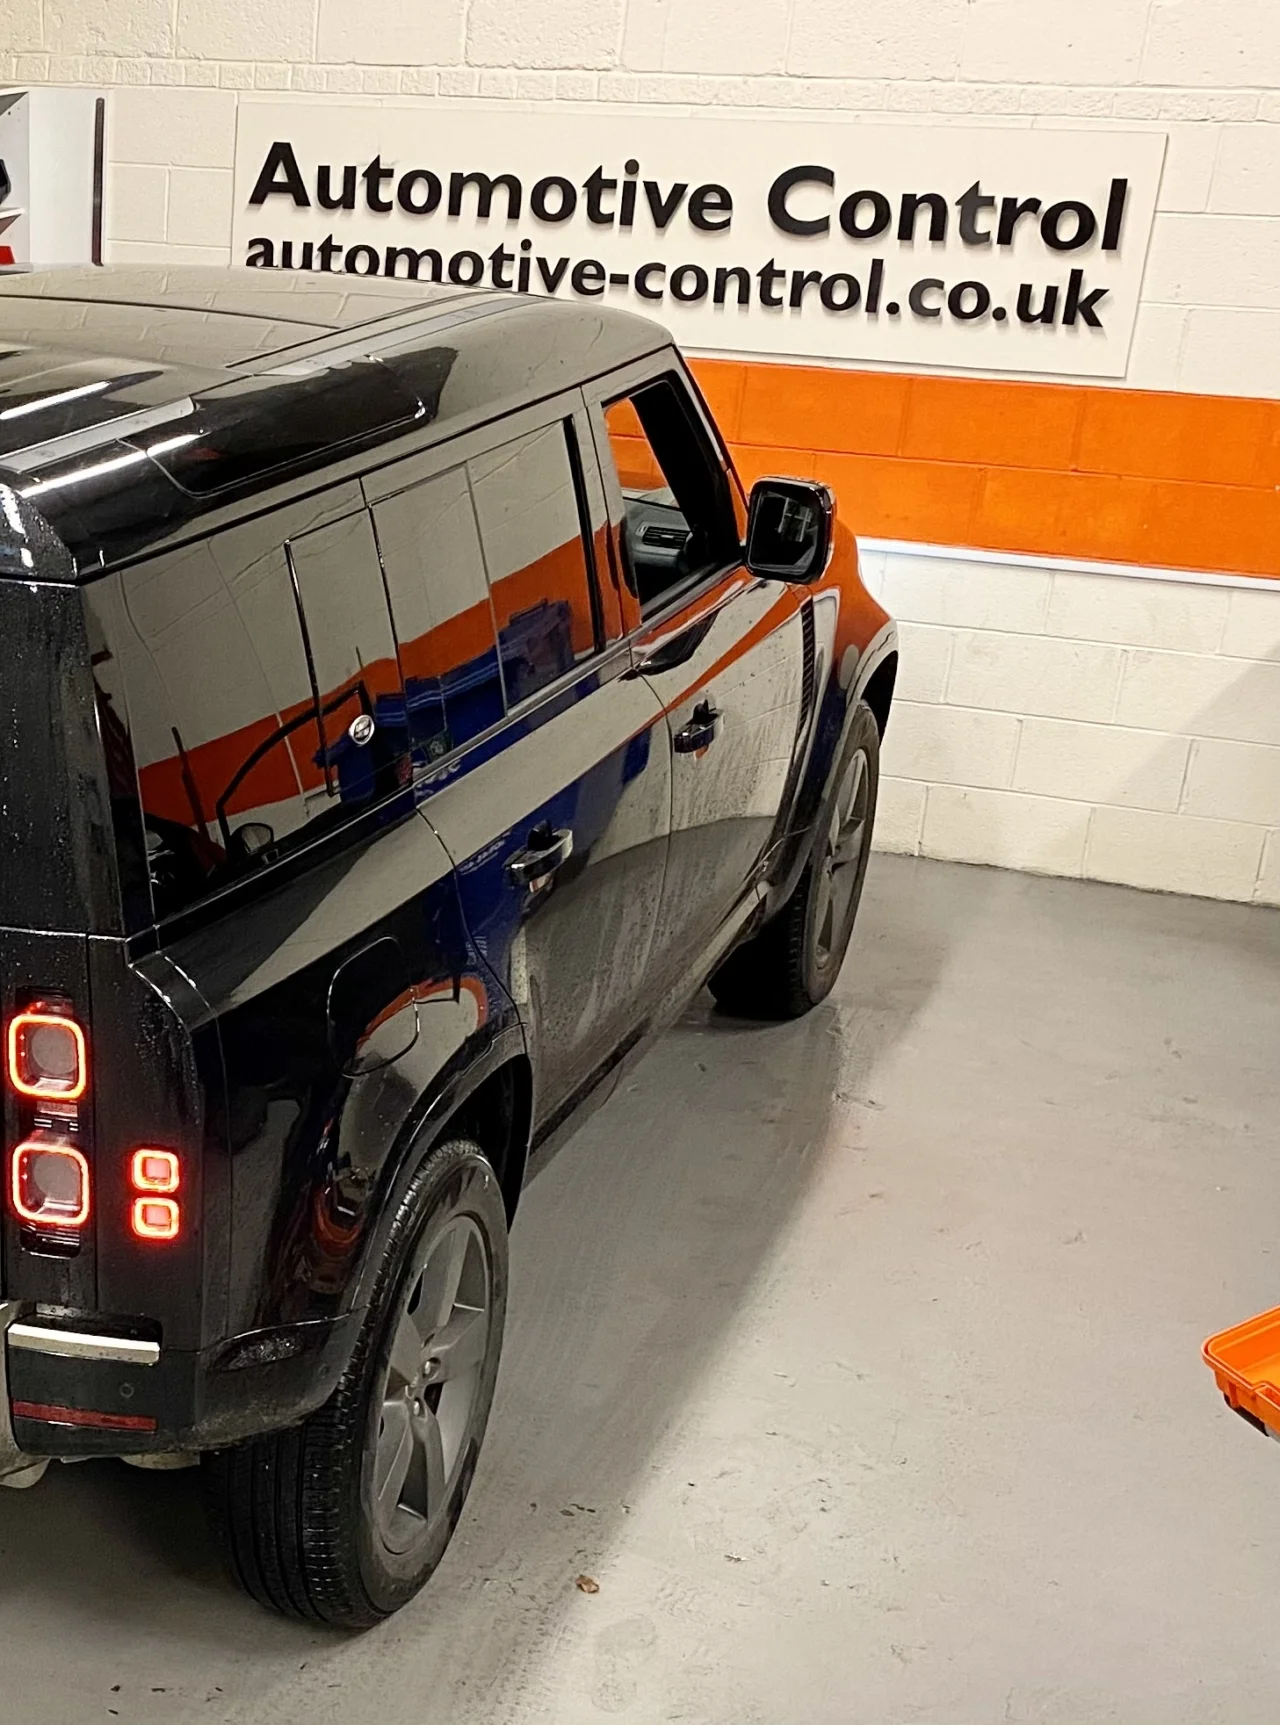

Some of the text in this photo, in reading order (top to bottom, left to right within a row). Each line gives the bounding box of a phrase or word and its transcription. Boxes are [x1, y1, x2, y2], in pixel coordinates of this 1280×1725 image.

[248, 141, 1128, 251] Automotive Control
[246, 233, 1110, 328] automotive-control.co.uk
